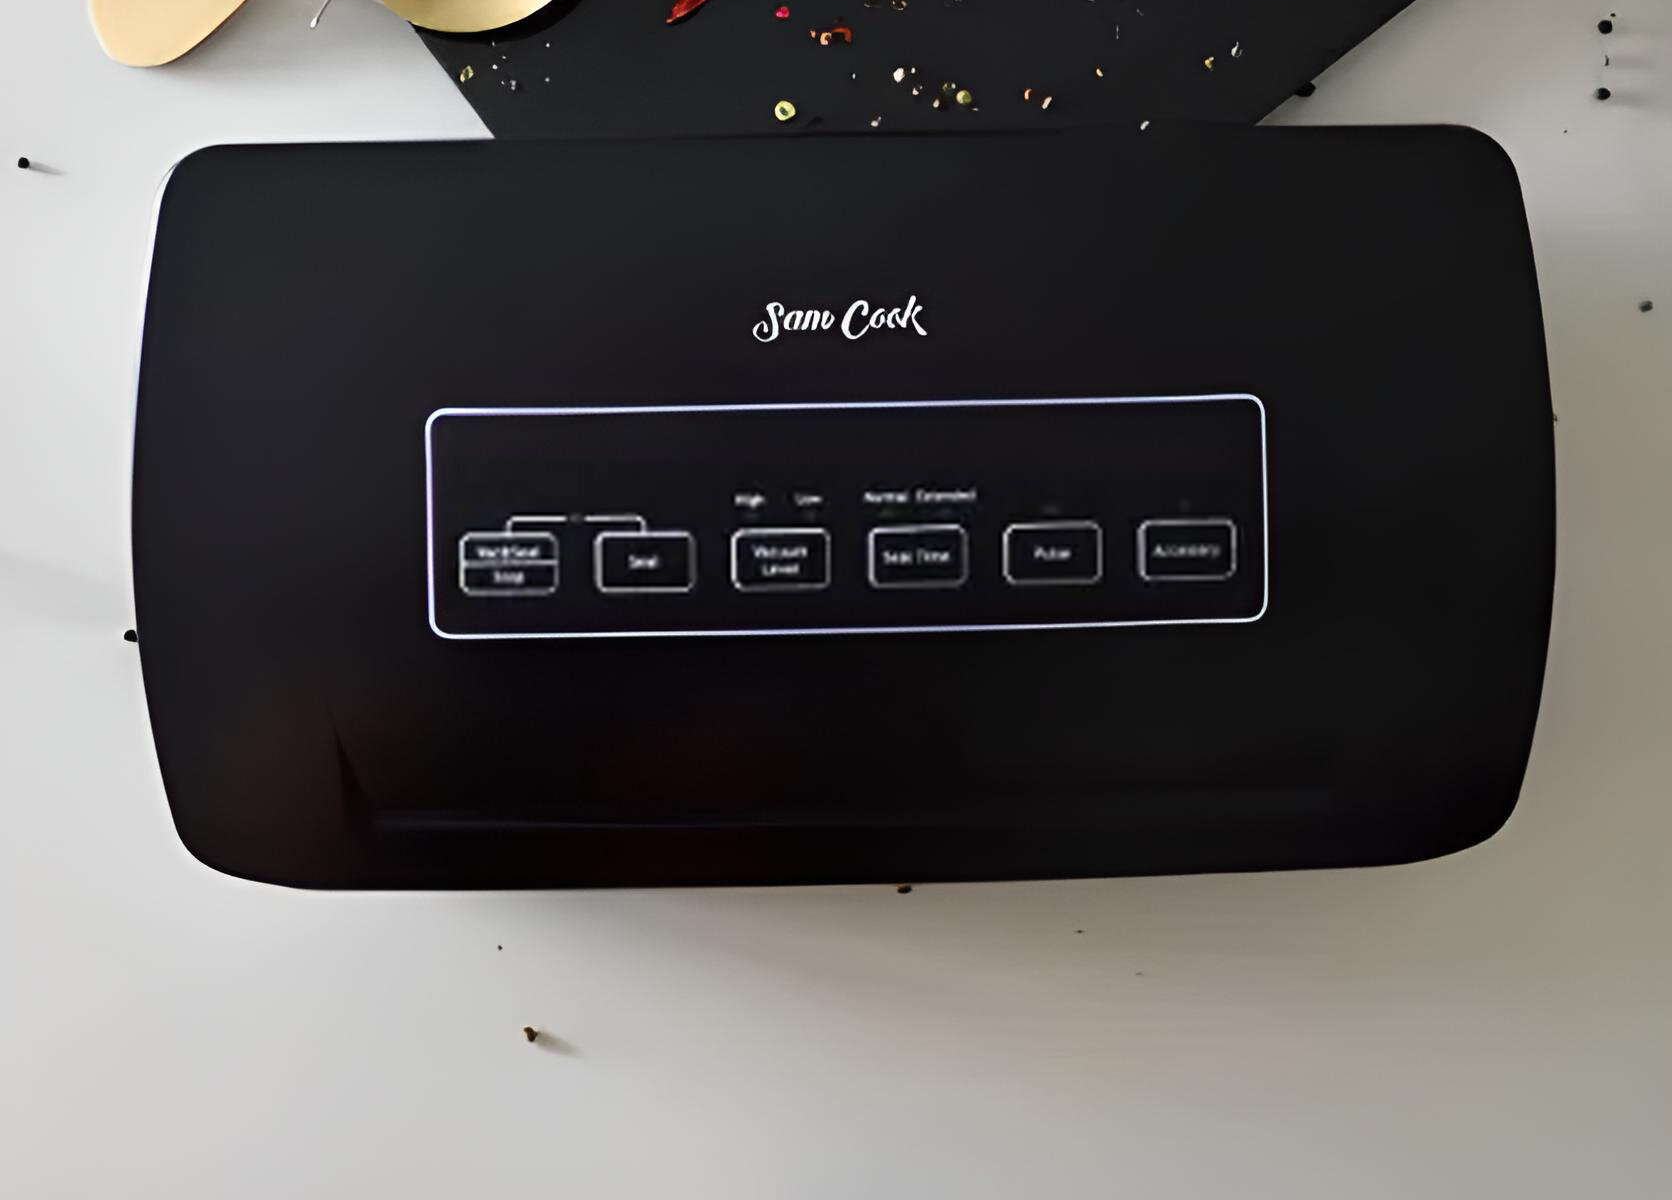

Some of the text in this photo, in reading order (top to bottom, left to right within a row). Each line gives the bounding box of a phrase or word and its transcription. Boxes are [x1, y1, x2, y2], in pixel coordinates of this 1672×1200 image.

[752, 295, 928, 342] Sam Cook
[863, 491, 909, 504] Normal
